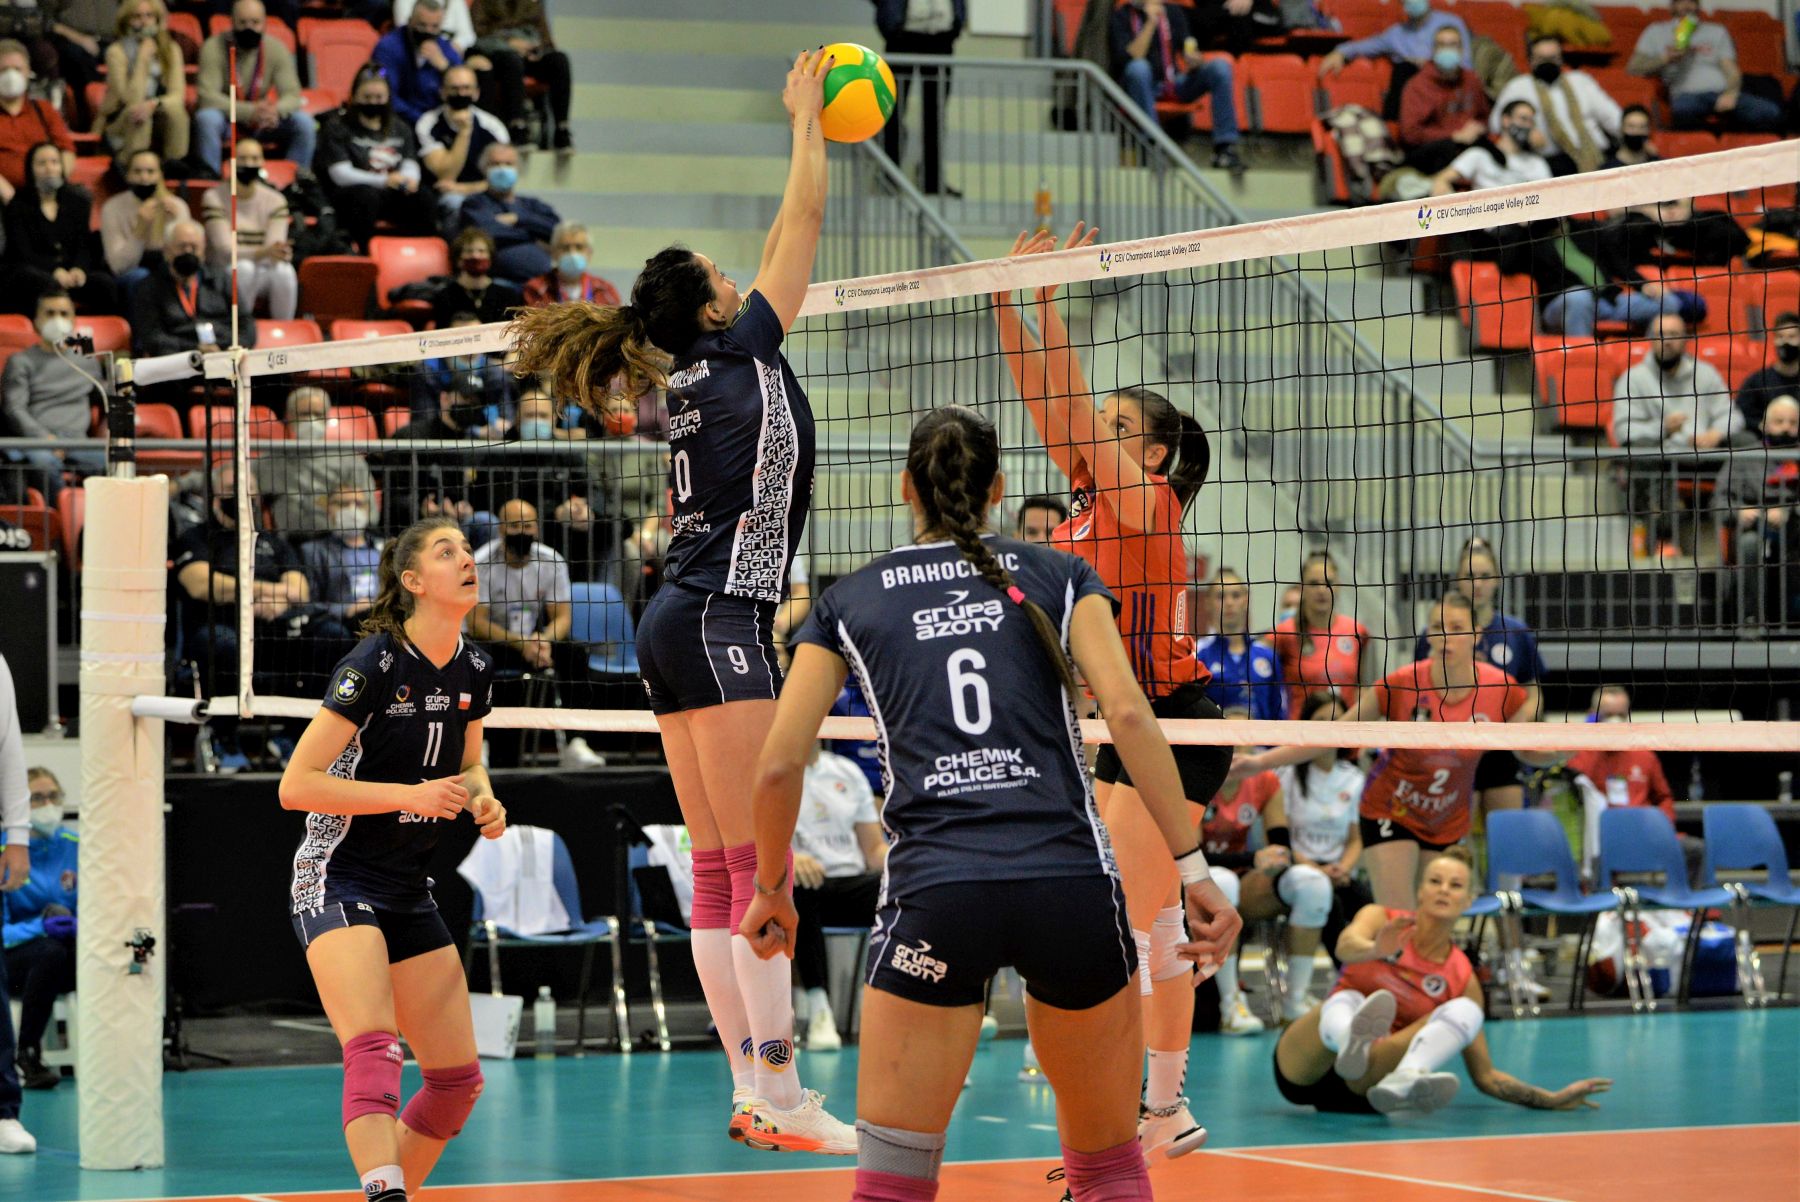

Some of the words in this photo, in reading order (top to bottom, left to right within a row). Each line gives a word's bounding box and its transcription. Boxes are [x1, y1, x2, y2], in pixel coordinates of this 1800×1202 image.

[1437, 210, 1449, 220] CEV
[1450, 207, 1482, 218] Champions
[1484, 202, 1504, 213] League
[1506, 198, 1524, 208] Volley
[1526, 194, 1540, 206] 2022
[1115, 254, 1126, 262] CEV
[1126, 251, 1152, 262] Champions
[1154, 249, 1170, 258] League
[1172, 246, 1188, 255] Volley
[1188, 242, 1200, 252] 2022
[848, 290, 857, 298] CEV
[858, 287, 880, 297] Champions
[880, 286, 896, 294] League
[896, 284, 909, 292] Volley
[909, 281, 920, 290] 2022
[881, 553, 1020, 589] BRAKOCIC
[912, 600, 1003, 625] GRUPA
[916, 614, 1006, 640] AZOTY
[727, 645, 749, 675] 9
[347, 672, 359, 681] CEV
[425, 696, 450, 704] GRUPA
[946, 648, 992, 735] 6
[425, 703, 450, 711] AZOTY
[422, 722, 443, 767] 11
[935, 748, 1024, 772] CHEMIK
[924, 763, 1007, 791] POLICE
[1010, 765, 1041, 778] S.A.
[1428, 768, 1450, 794] 2
[1378, 818, 1393, 838] 2
[891, 955, 946, 983] AZOTY
[895, 944, 948, 974] GRUPA
